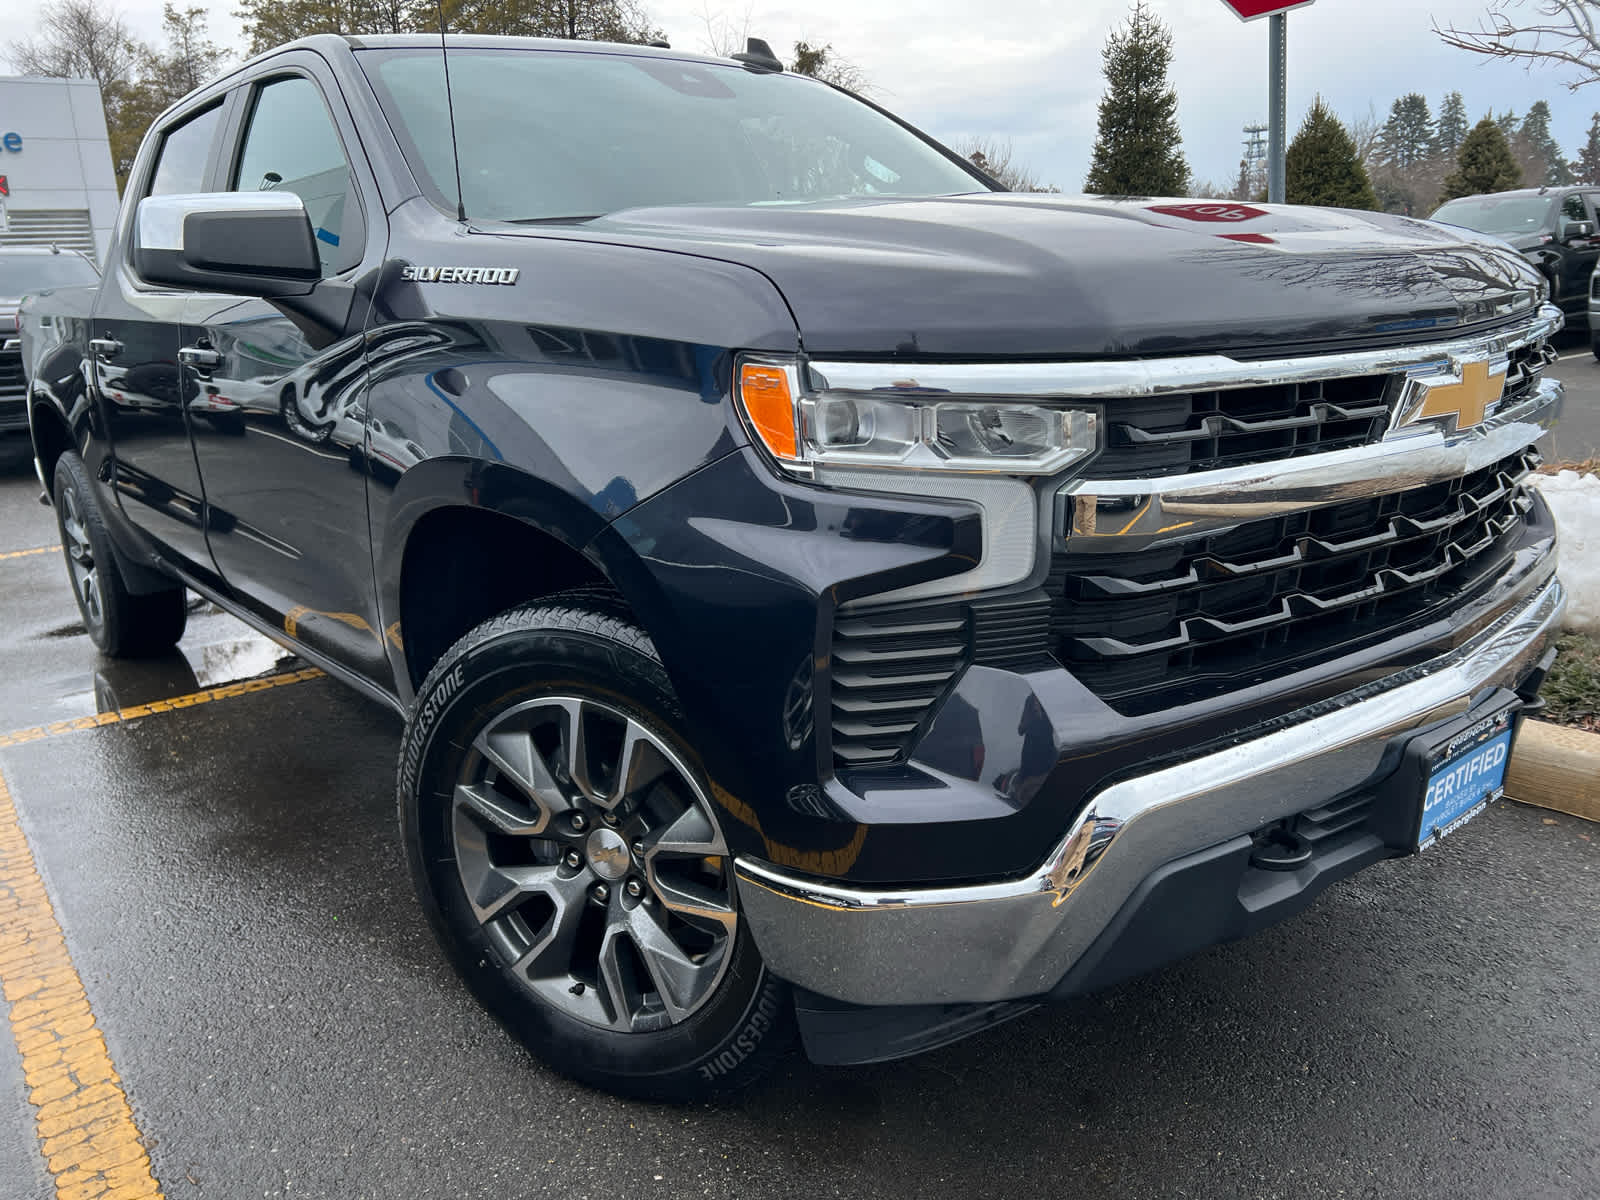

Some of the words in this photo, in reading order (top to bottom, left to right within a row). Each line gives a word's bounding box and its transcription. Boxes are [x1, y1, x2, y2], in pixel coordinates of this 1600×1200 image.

[0, 132, 23, 152] e
[401, 265, 521, 285] SILVERADO
[1423, 742, 1507, 812] CERTIFIED
